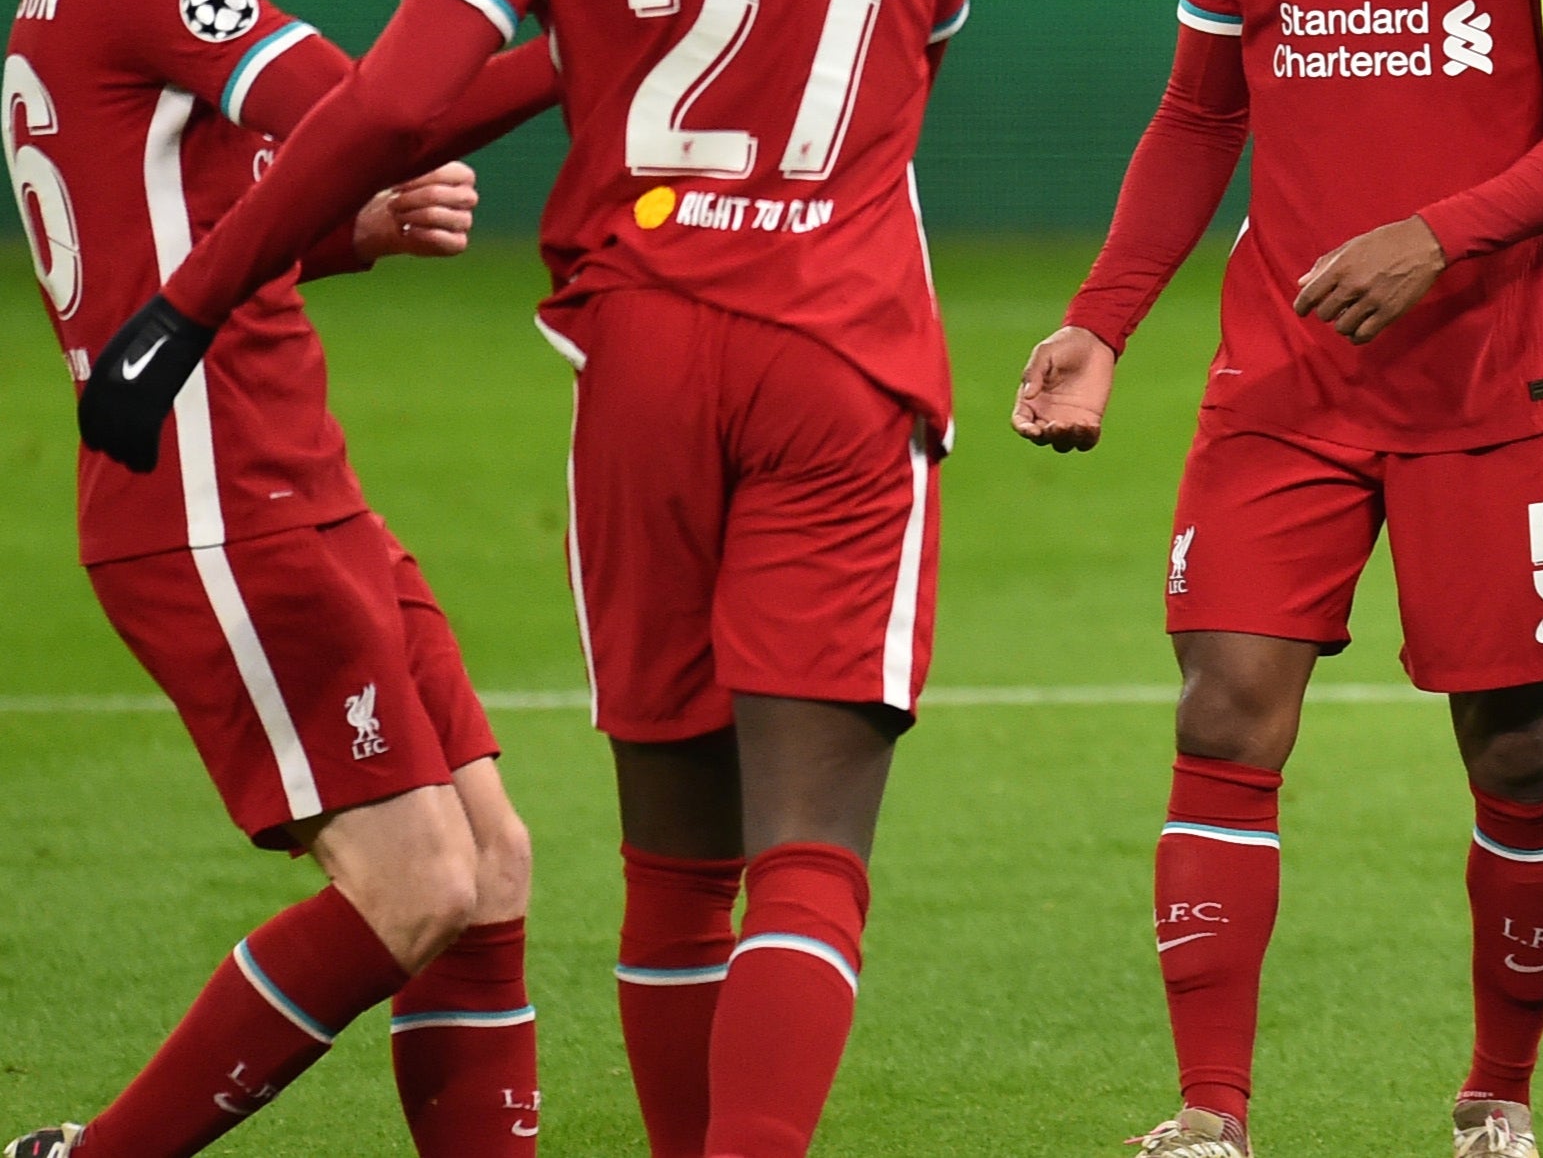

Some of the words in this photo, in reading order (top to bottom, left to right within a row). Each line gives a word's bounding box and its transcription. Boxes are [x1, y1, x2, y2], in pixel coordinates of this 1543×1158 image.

[1280, 1, 1429, 36] Standard
[1273, 43, 1432, 78] Chartered
[1, 53, 83, 321] 6
[676, 190, 750, 232] RIGHT
[751, 199, 785, 232] TO
[781, 199, 834, 234] PLAY
